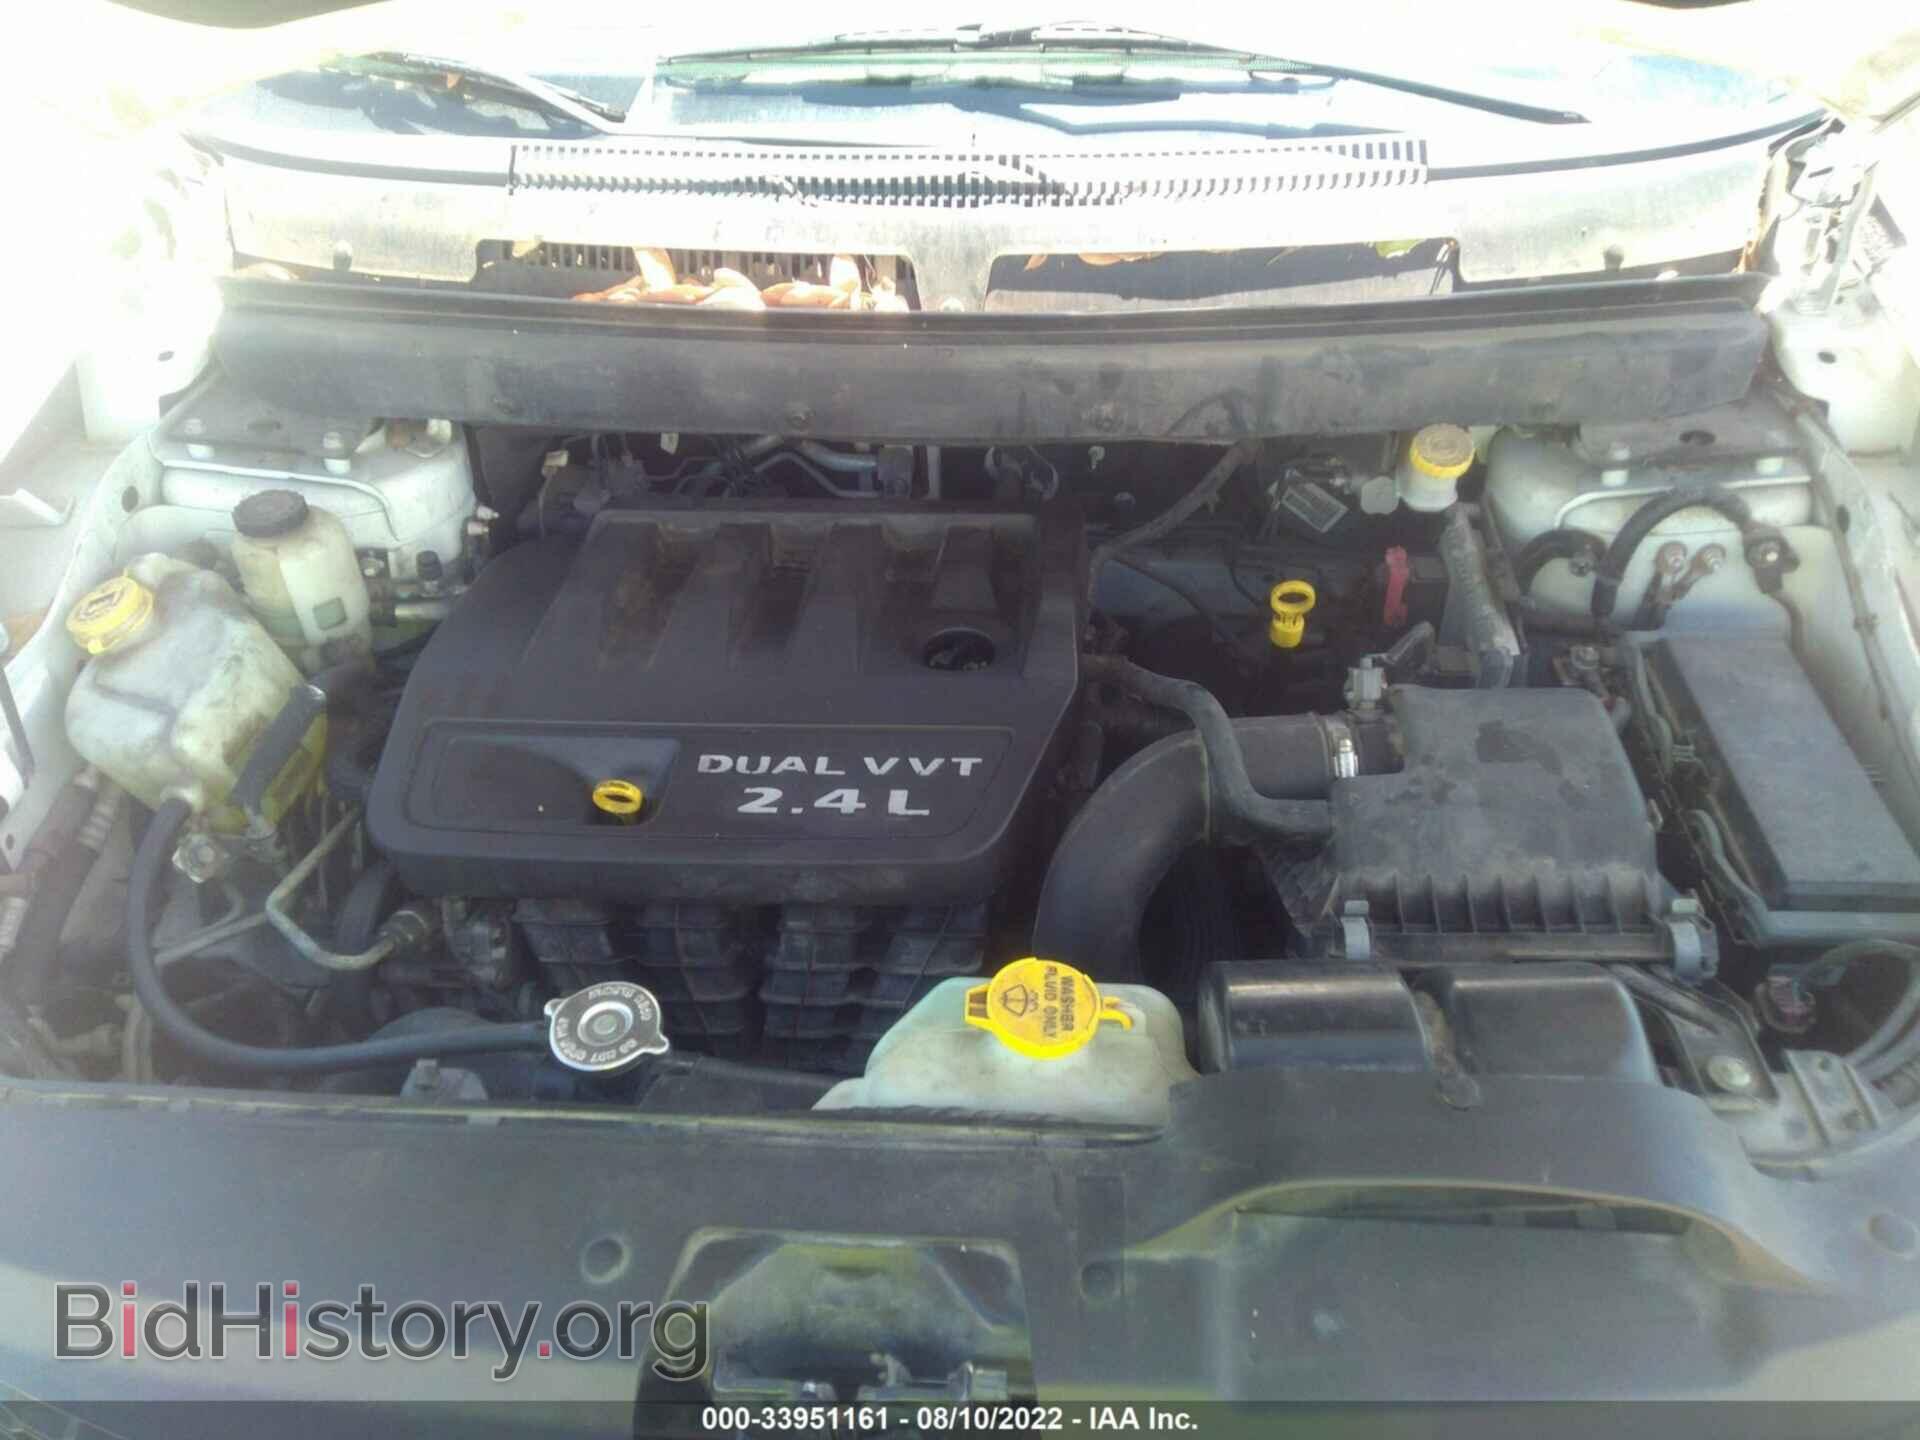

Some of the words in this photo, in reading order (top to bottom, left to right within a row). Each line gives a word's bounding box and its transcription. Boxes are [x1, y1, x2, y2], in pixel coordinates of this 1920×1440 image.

[697, 754, 846, 776] DUAL
[863, 756, 983, 777] VVT
[1044, 965, 1058, 1001] FLUID
[1060, 975, 1075, 1031] WASHER
[1043, 1005, 1058, 1038] ONLY
